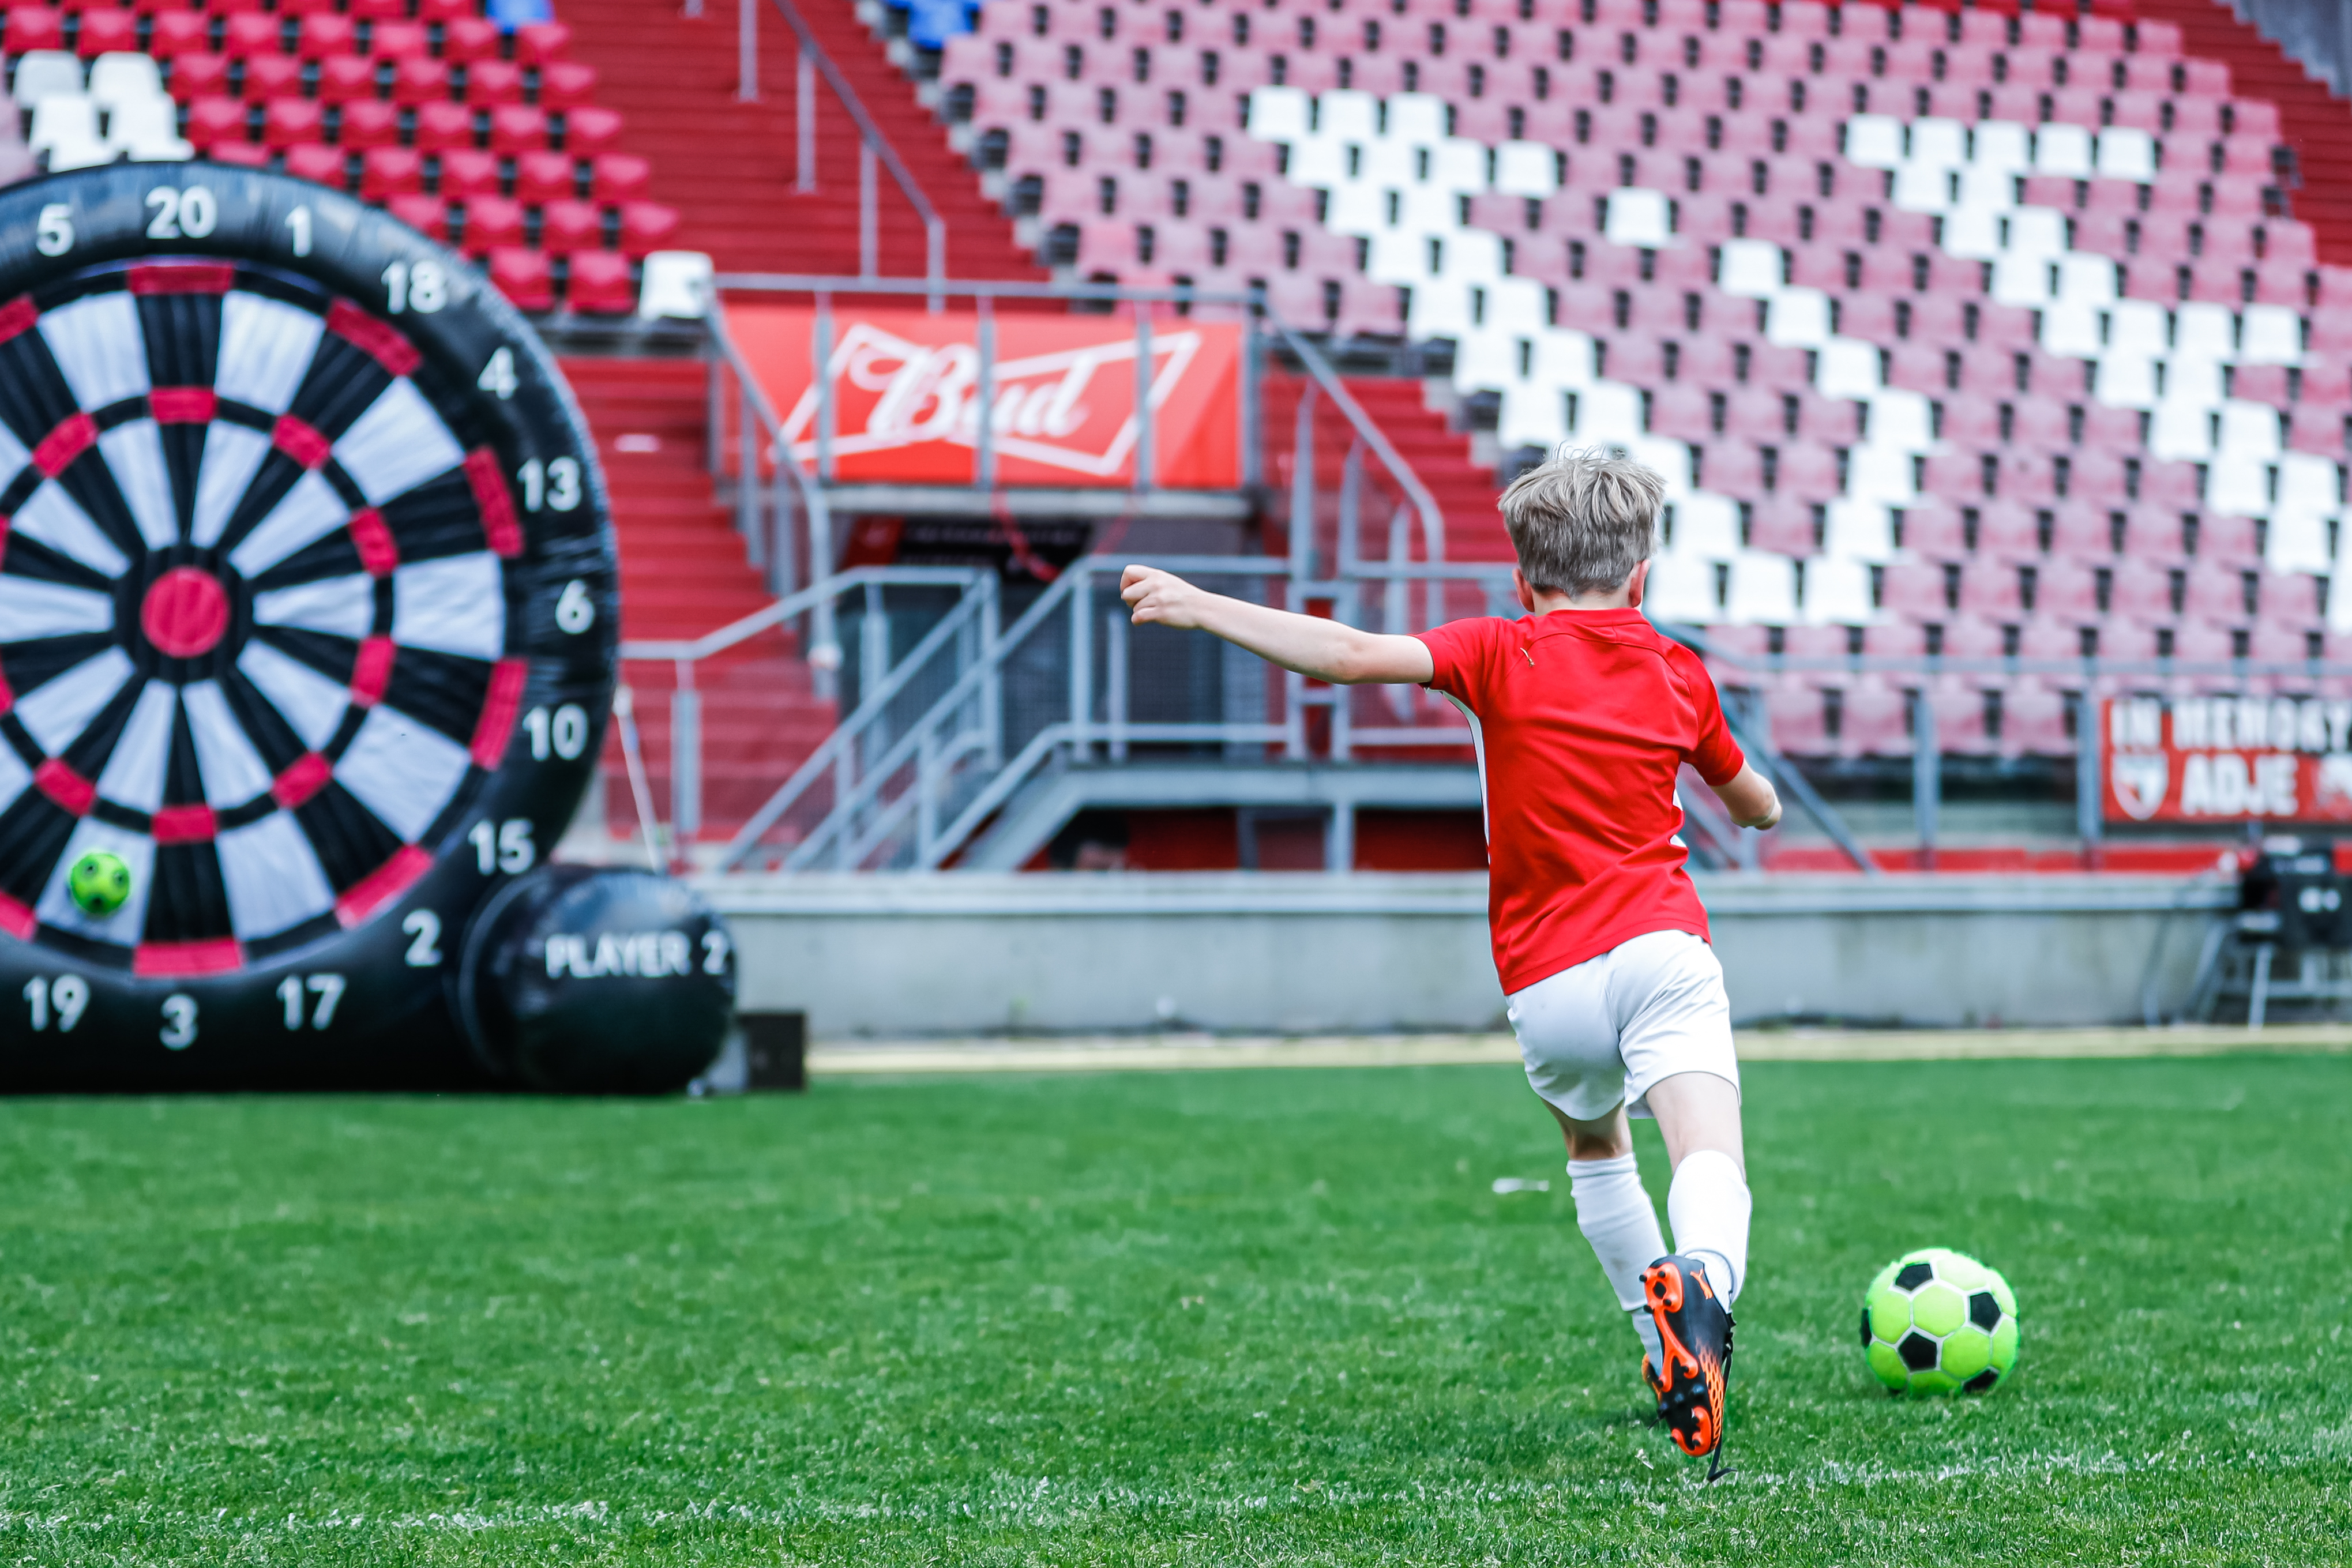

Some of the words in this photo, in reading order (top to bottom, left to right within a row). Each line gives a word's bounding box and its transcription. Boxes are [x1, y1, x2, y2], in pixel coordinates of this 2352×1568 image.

[36, 204, 75, 256] 5
[145, 186, 217, 239] 20
[285, 205, 311, 256] 1
[382, 261, 448, 314] 18
[478, 347, 517, 399] 4
[849, 344, 1089, 441] Bud
[517, 457, 580, 511] 13
[555, 580, 595, 633] 6
[525, 706, 587, 759] 10
[2111, 699, 2161, 749] IN
[2181, 754, 2298, 815] ADJE
[469, 821, 534, 874] 15
[403, 910, 441, 965] 2
[546, 935, 690, 978] PLAYER
[704, 933, 728, 975] 2
[25, 976, 88, 1030] 19
[161, 995, 197, 1050] 3
[279, 975, 345, 1029] 17
